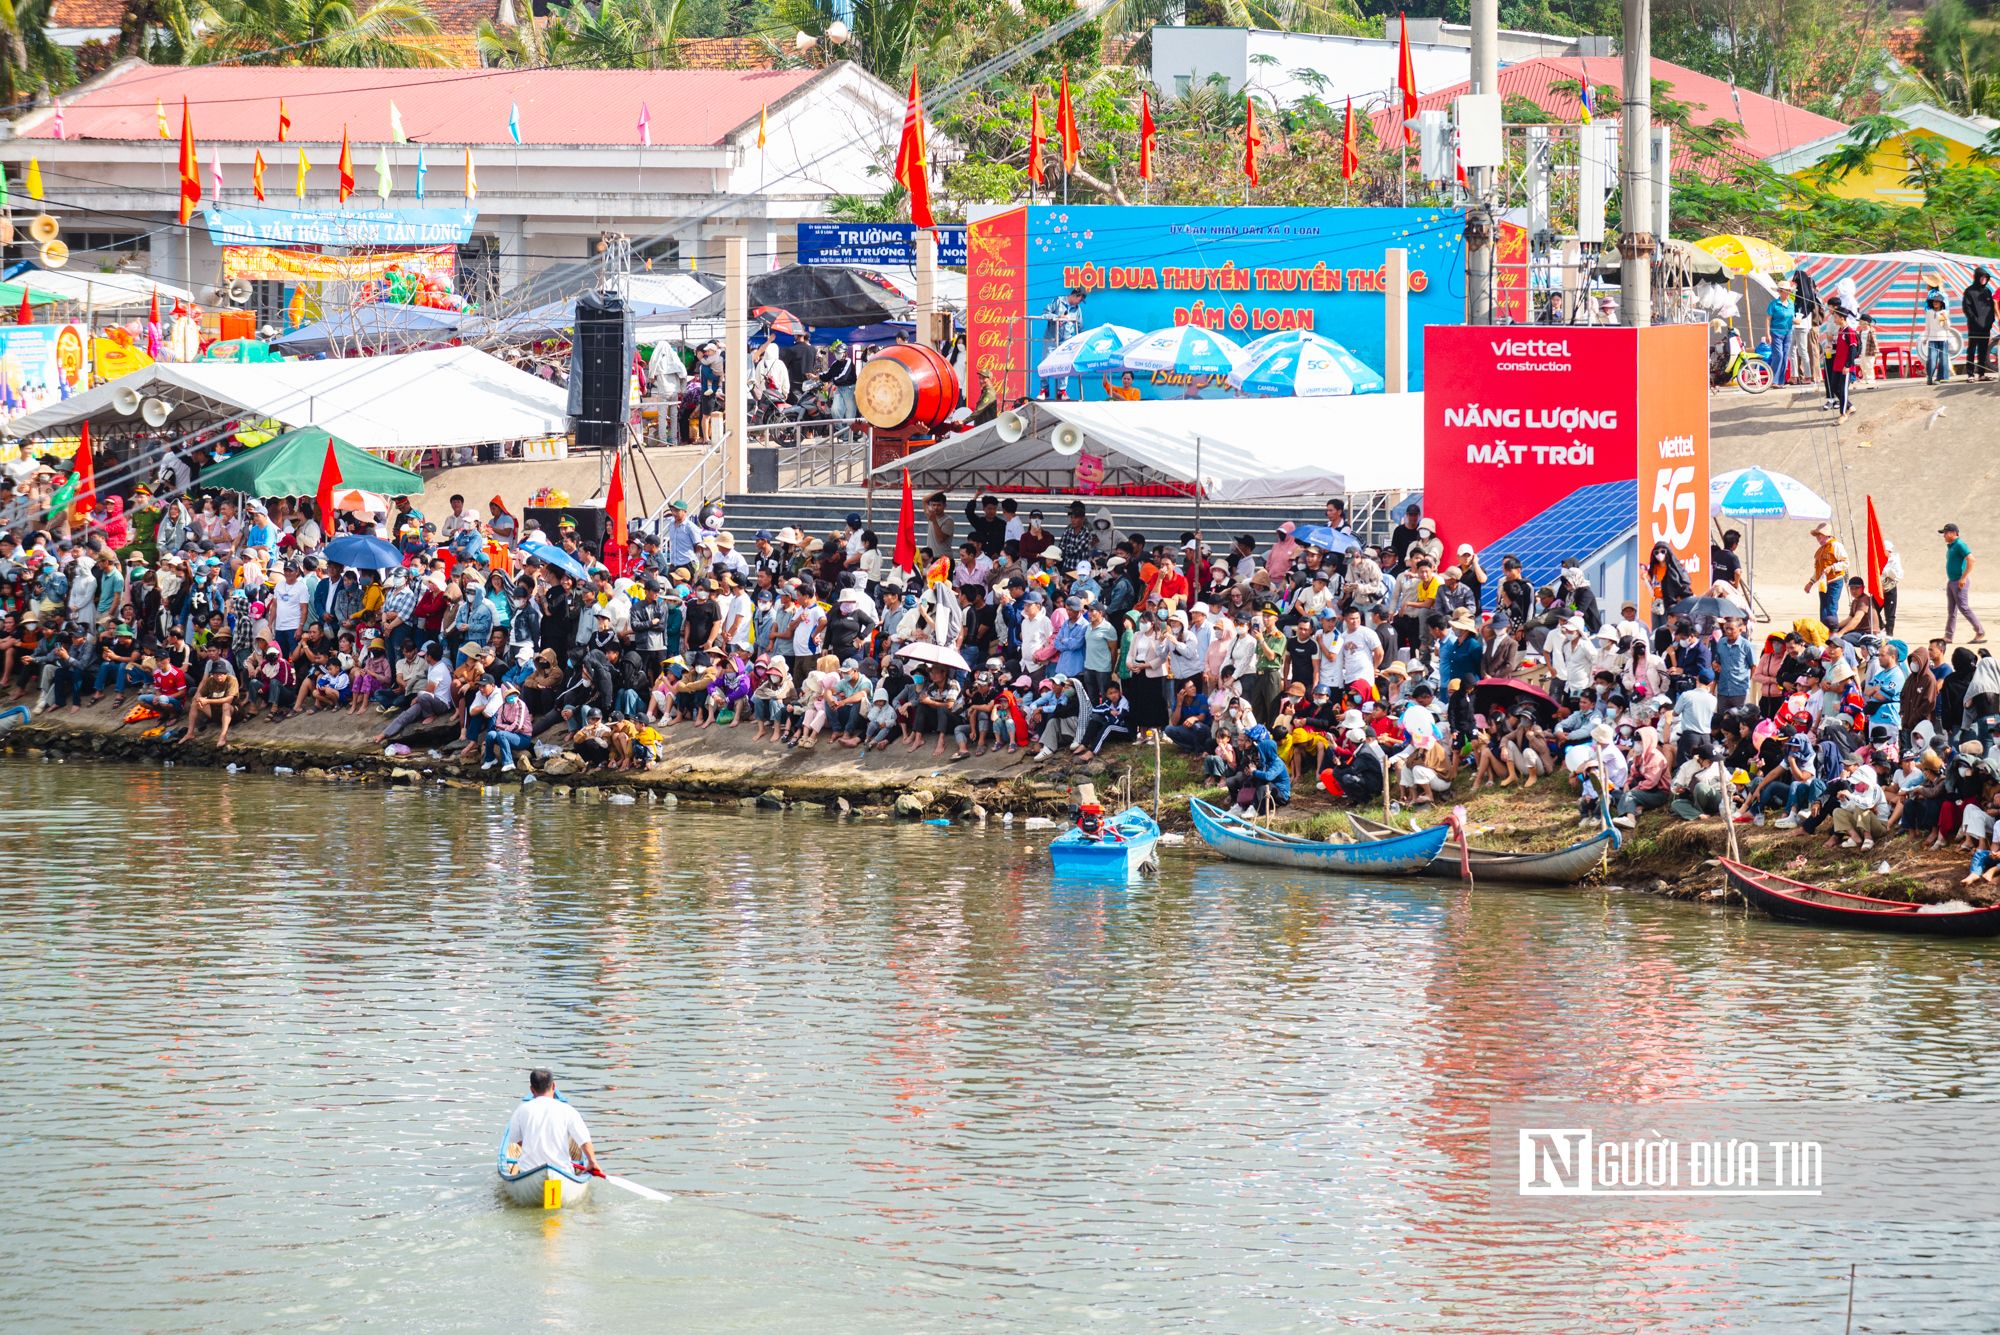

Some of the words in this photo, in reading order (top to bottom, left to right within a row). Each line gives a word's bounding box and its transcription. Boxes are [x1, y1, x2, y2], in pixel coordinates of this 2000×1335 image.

[222, 220, 257, 242] NHÀ
[261, 220, 293, 242] VĂN
[297, 220, 331, 242] HÓA
[335, 220, 380, 242] THÔN
[384, 220, 417, 241] TÂN
[422, 222, 463, 240] LONG
[838, 228, 902, 244] TRƯỜNG
[1186, 226, 1207, 235] BAN
[1210, 224, 1240, 235] NHÂN
[1283, 225, 1290, 235] Ô
[1294, 226, 1320, 236] LOAN
[856, 247, 906, 256] TRƯỜNG
[976, 258, 1016, 278] Năm
[1063, 261, 1106, 294] HỘI
[1109, 266, 1158, 289] ĐUA
[1162, 260, 1250, 290] THUYỀN
[1254, 261, 1342, 291] TRUYỀN
[1346, 264, 1428, 292] THG
[978, 282, 1014, 301] Mới
[974, 306, 1019, 328] Hạnh
[1174, 300, 1225, 330] ĐẦM
[1228, 303, 1248, 330] Ô
[1252, 308, 1314, 331] LOAN
[1491, 338, 1571, 357] viettel
[976, 353, 1016, 372] Bình
[1497, 362, 1572, 372] construction
[1444, 403, 1520, 428] NĂNG
[1525, 407, 1617, 433] LƯỢNG
[1467, 440, 1528, 468] MẶT
[1531, 440, 1594, 466] TRỜI
[1658, 434, 1695, 458] viettel
[1652, 466, 1696, 550] 5G
[550, 1187, 557, 1206] 1
